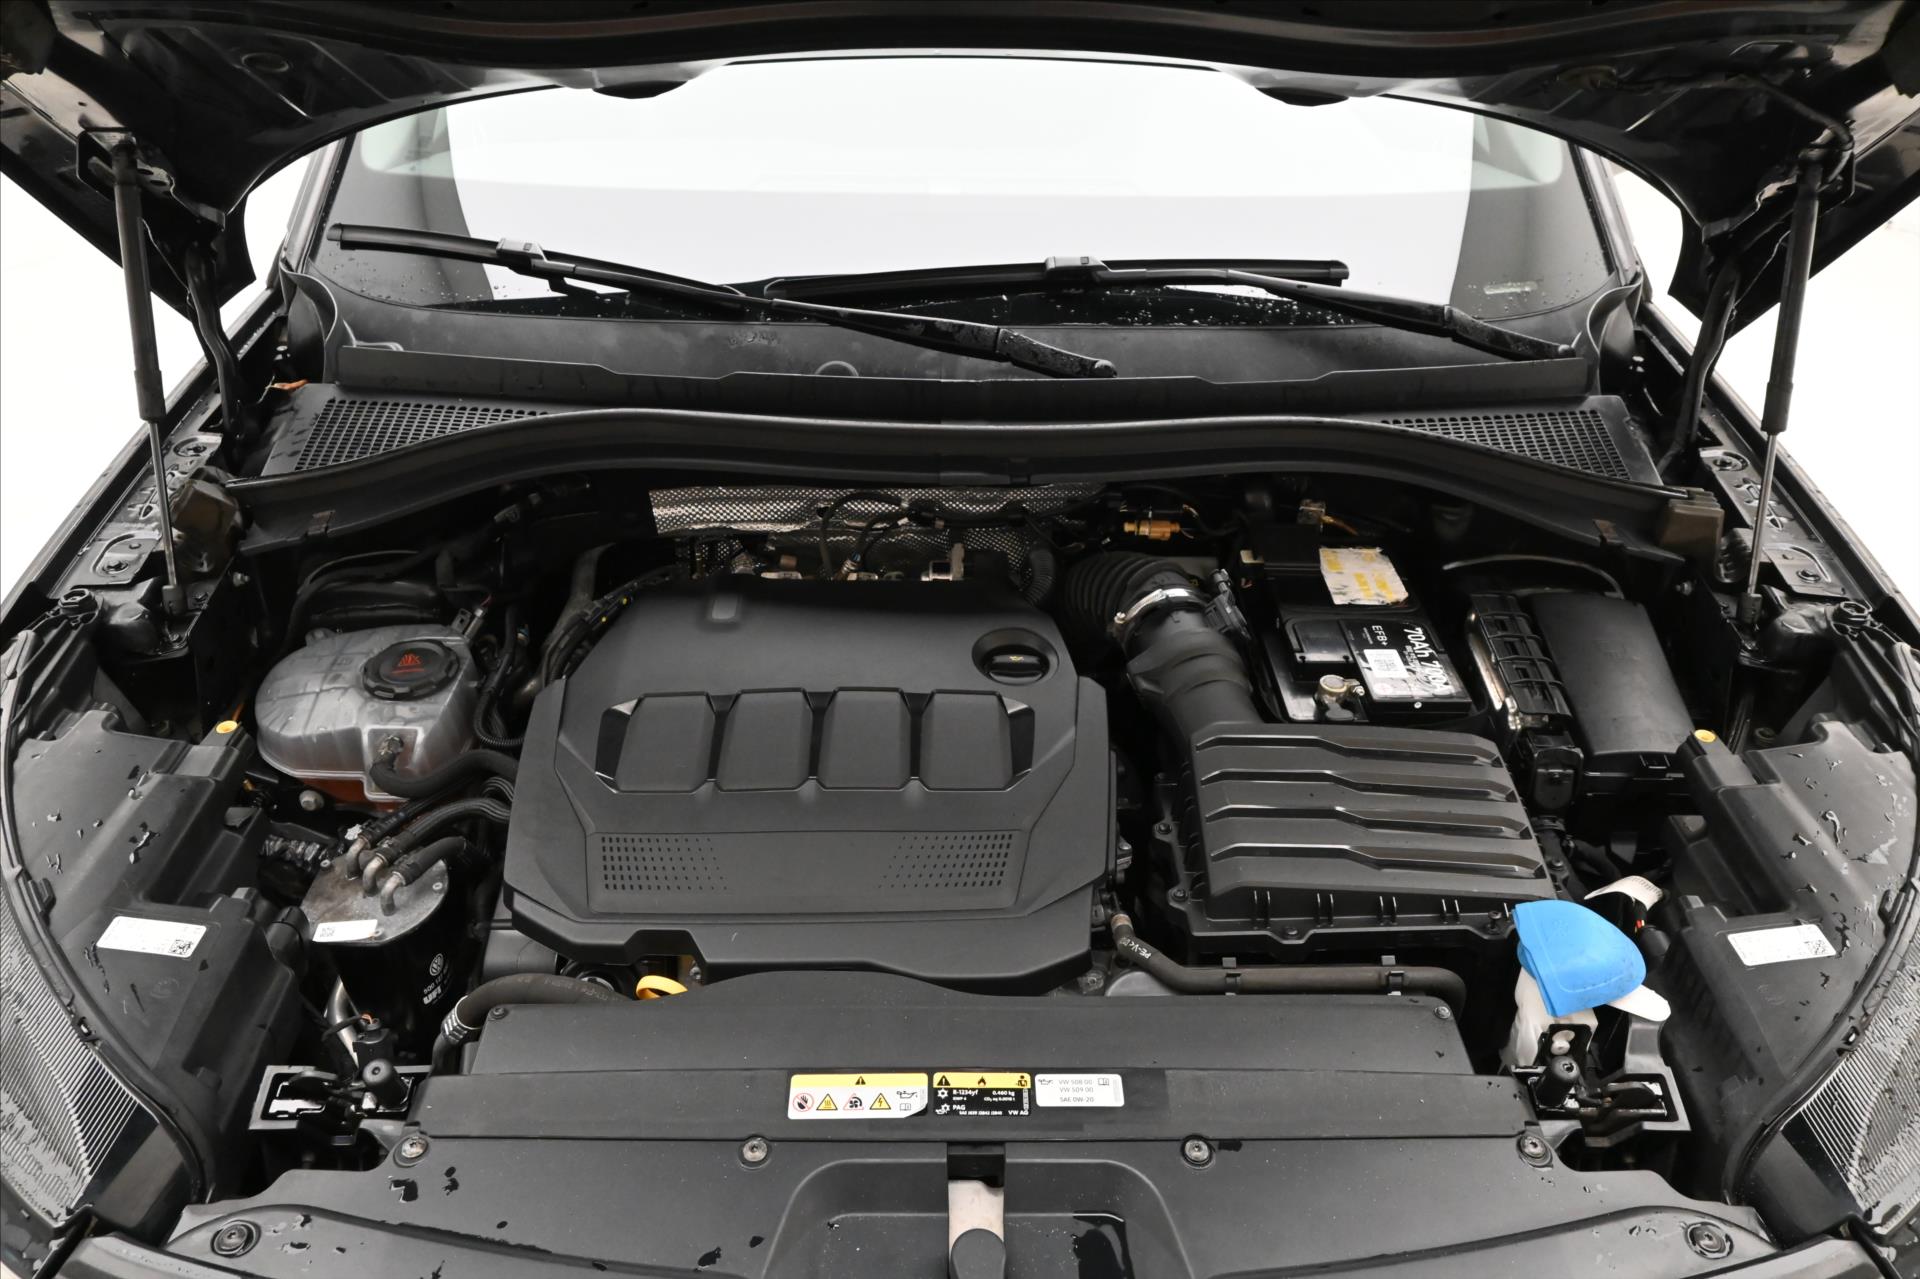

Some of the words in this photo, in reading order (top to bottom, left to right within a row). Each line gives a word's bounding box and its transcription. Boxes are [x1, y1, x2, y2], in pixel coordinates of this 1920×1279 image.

[1371, 625, 1388, 646] EFB+
[1403, 627, 1434, 658] 70Ah
[952, 1089, 979, 1097] R-1234yf
